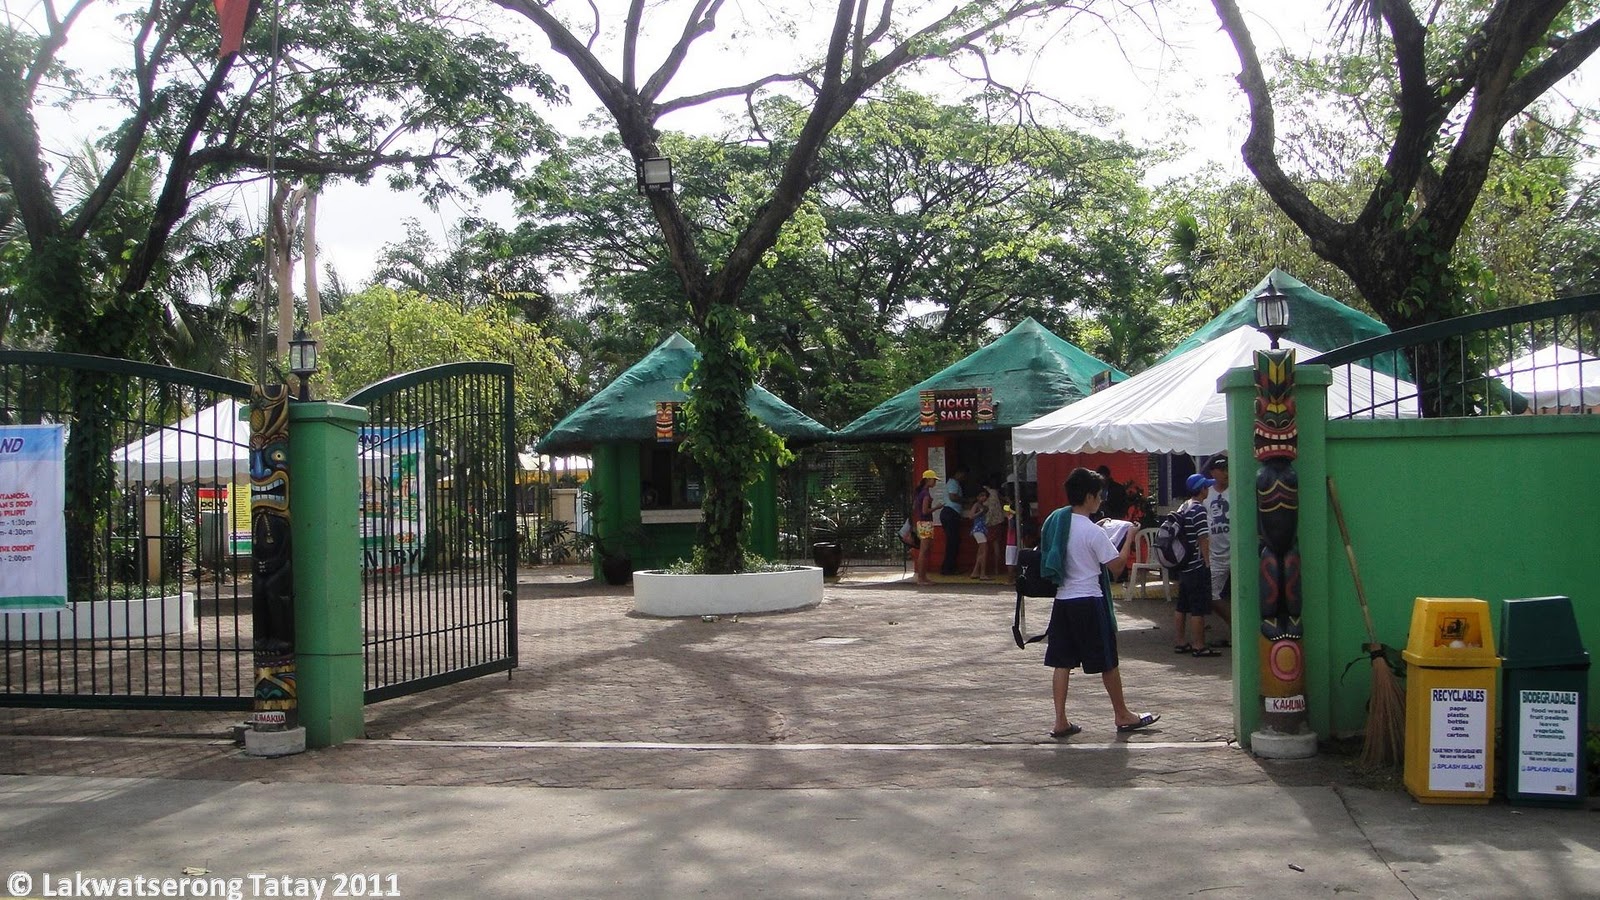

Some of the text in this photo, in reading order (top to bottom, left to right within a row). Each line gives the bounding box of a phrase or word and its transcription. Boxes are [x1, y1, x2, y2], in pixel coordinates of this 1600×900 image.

[937, 398, 976, 408] TICKET
[940, 410, 972, 420] SALES
[1432, 690, 1484, 702] RECYCLABLES
[1522, 692, 1576, 704] BIODEGRADABLE
